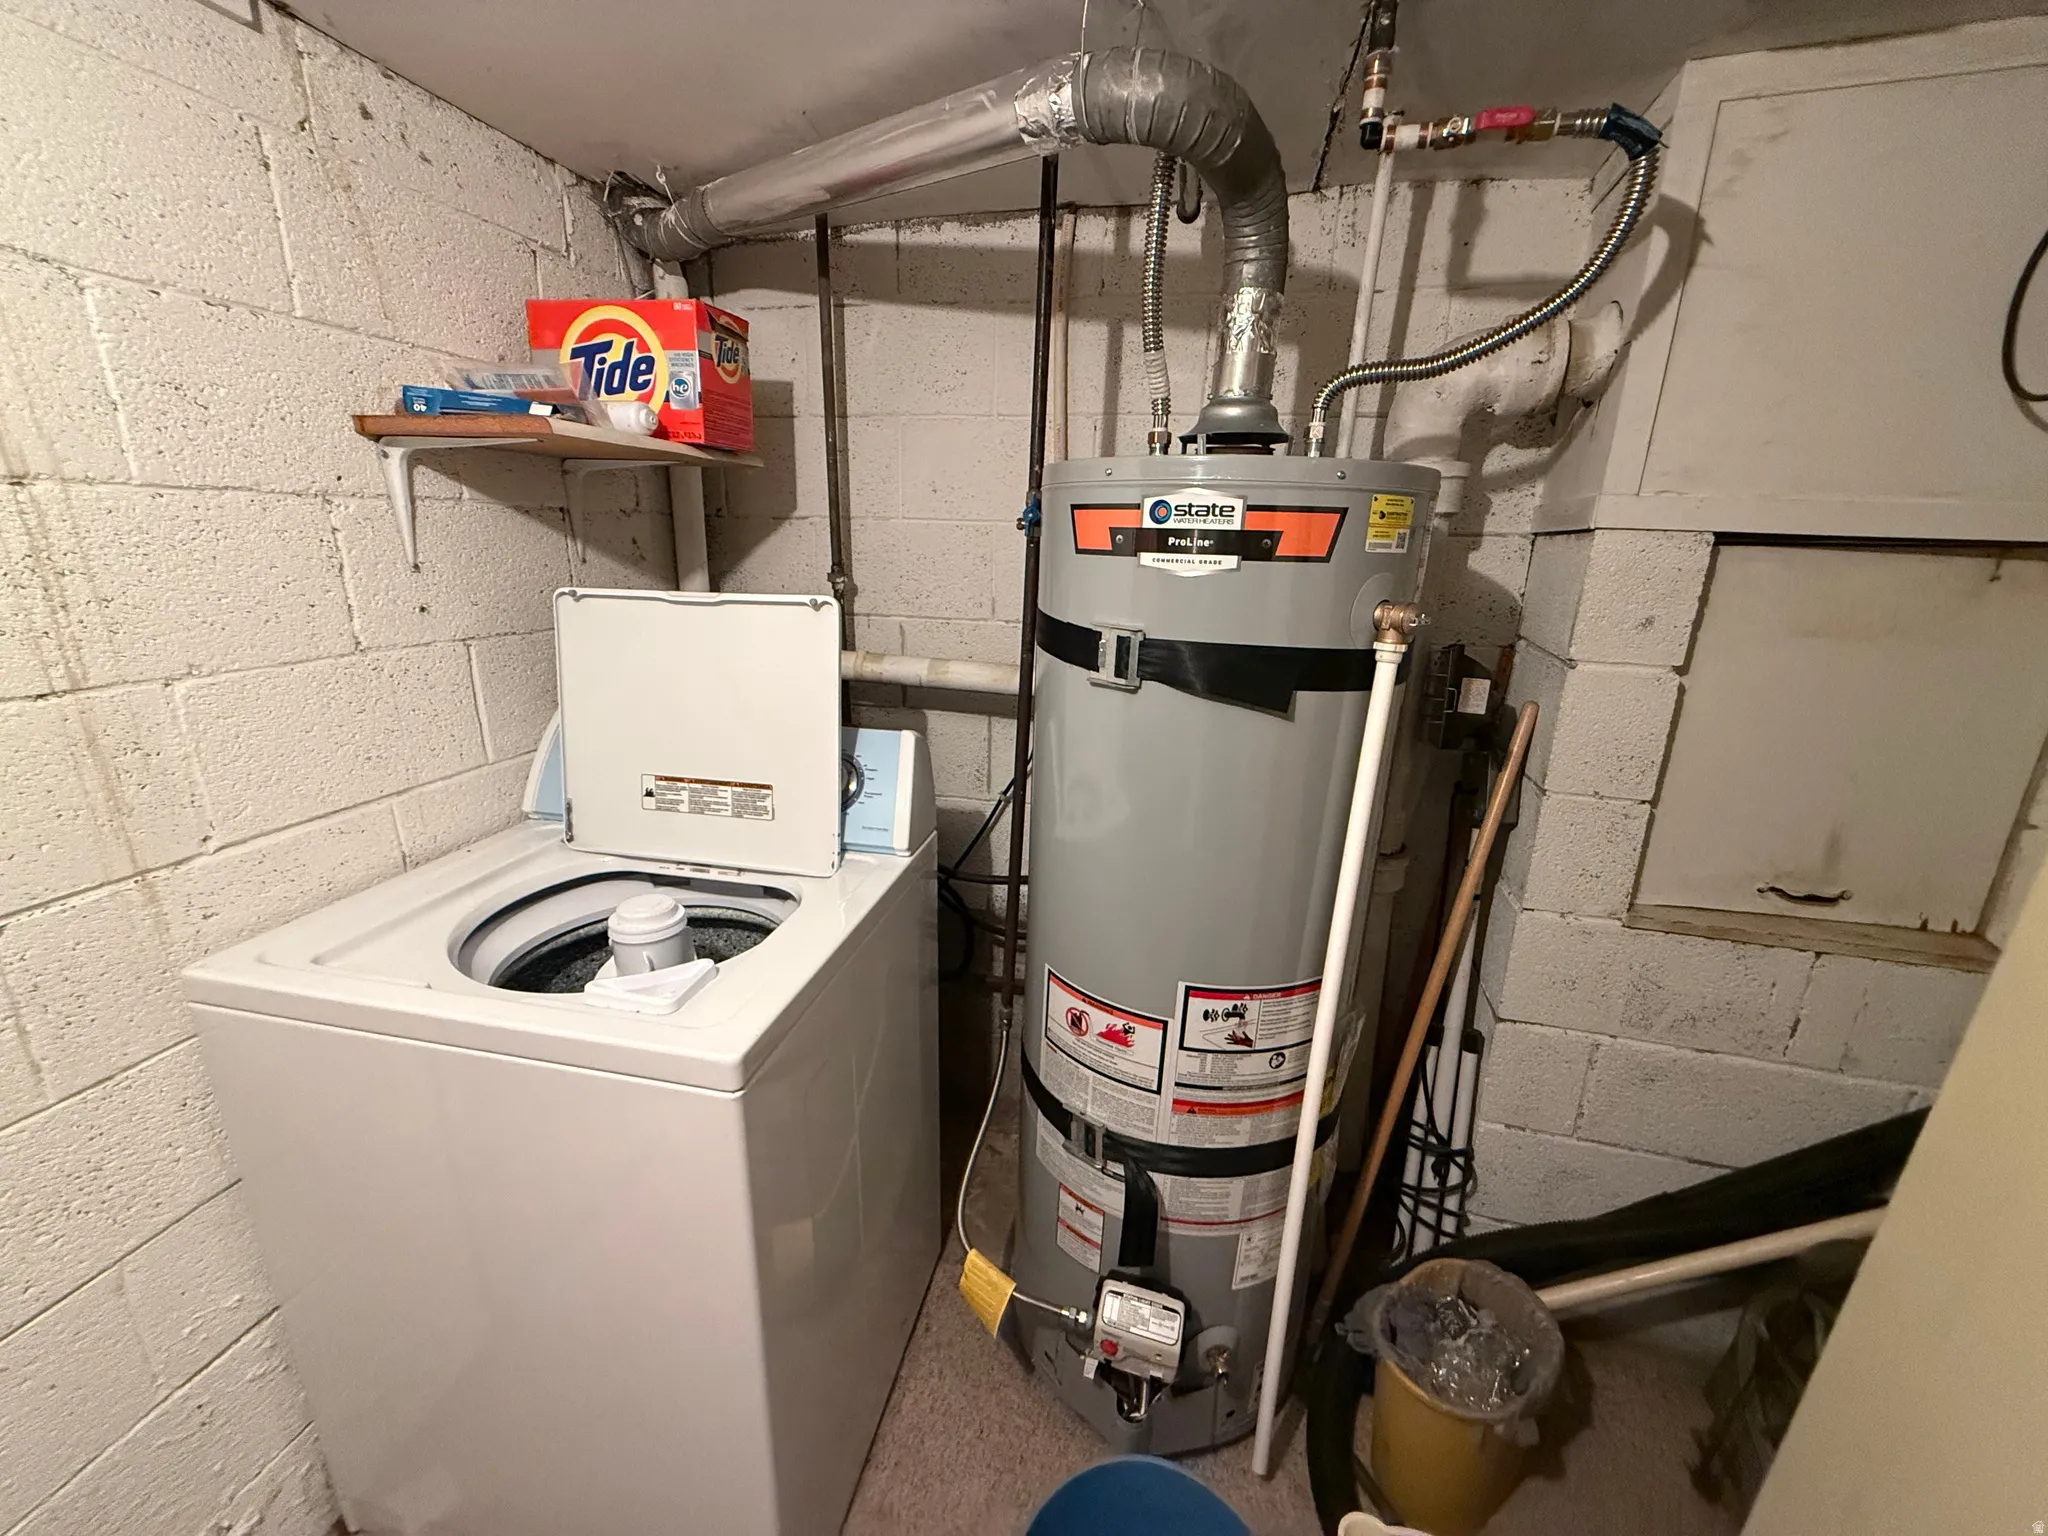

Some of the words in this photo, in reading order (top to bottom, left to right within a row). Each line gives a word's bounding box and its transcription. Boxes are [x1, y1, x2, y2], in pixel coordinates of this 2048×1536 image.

[714, 334, 740, 367] Tide
[569, 338, 656, 399] Tide
[1173, 503, 1235, 517] state
